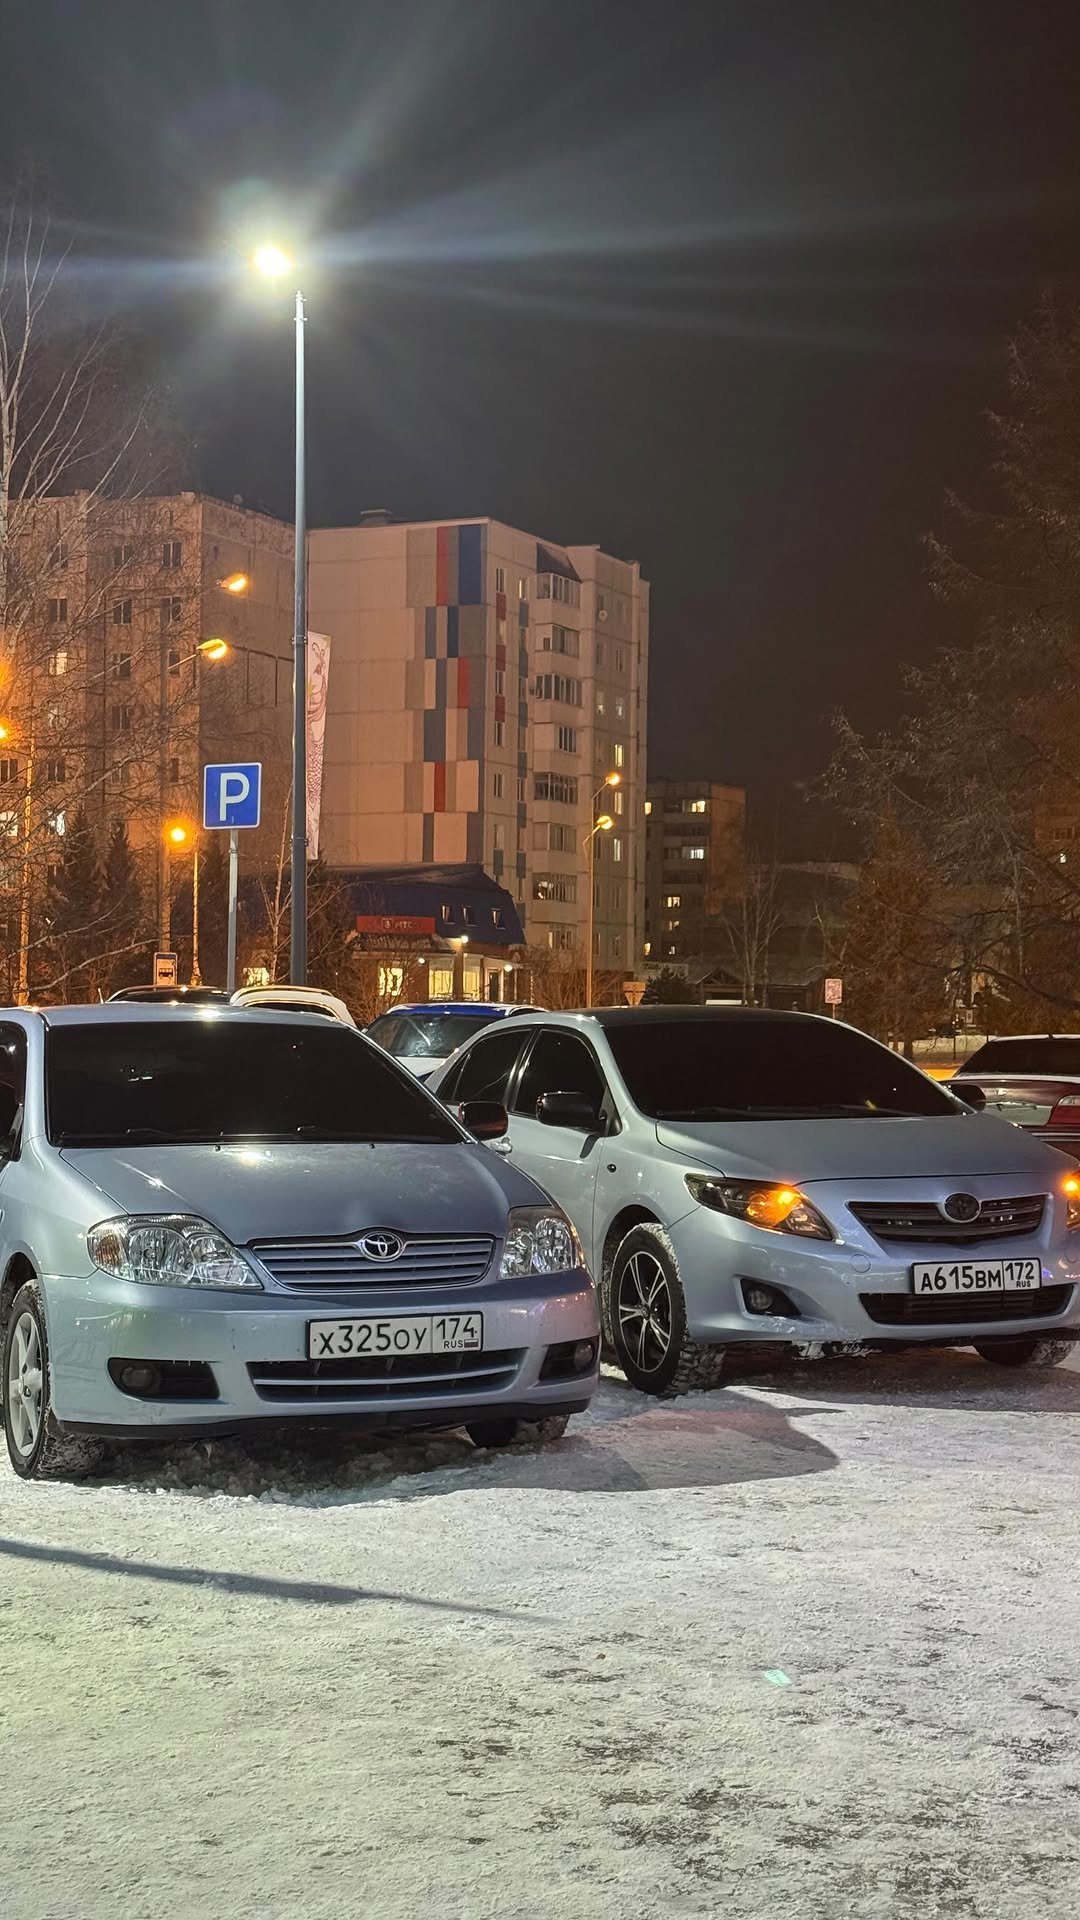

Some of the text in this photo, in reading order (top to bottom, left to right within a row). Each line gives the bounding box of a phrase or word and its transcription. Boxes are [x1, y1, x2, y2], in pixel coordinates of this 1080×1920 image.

[219, 772, 250, 822] P
[921, 1261, 1035, 1291] А615ВМ 172
[1016, 1280, 1031, 1288] RUS
[319, 1316, 475, 1355] Х325ОУ 174
[443, 1340, 464, 1349] RUS
